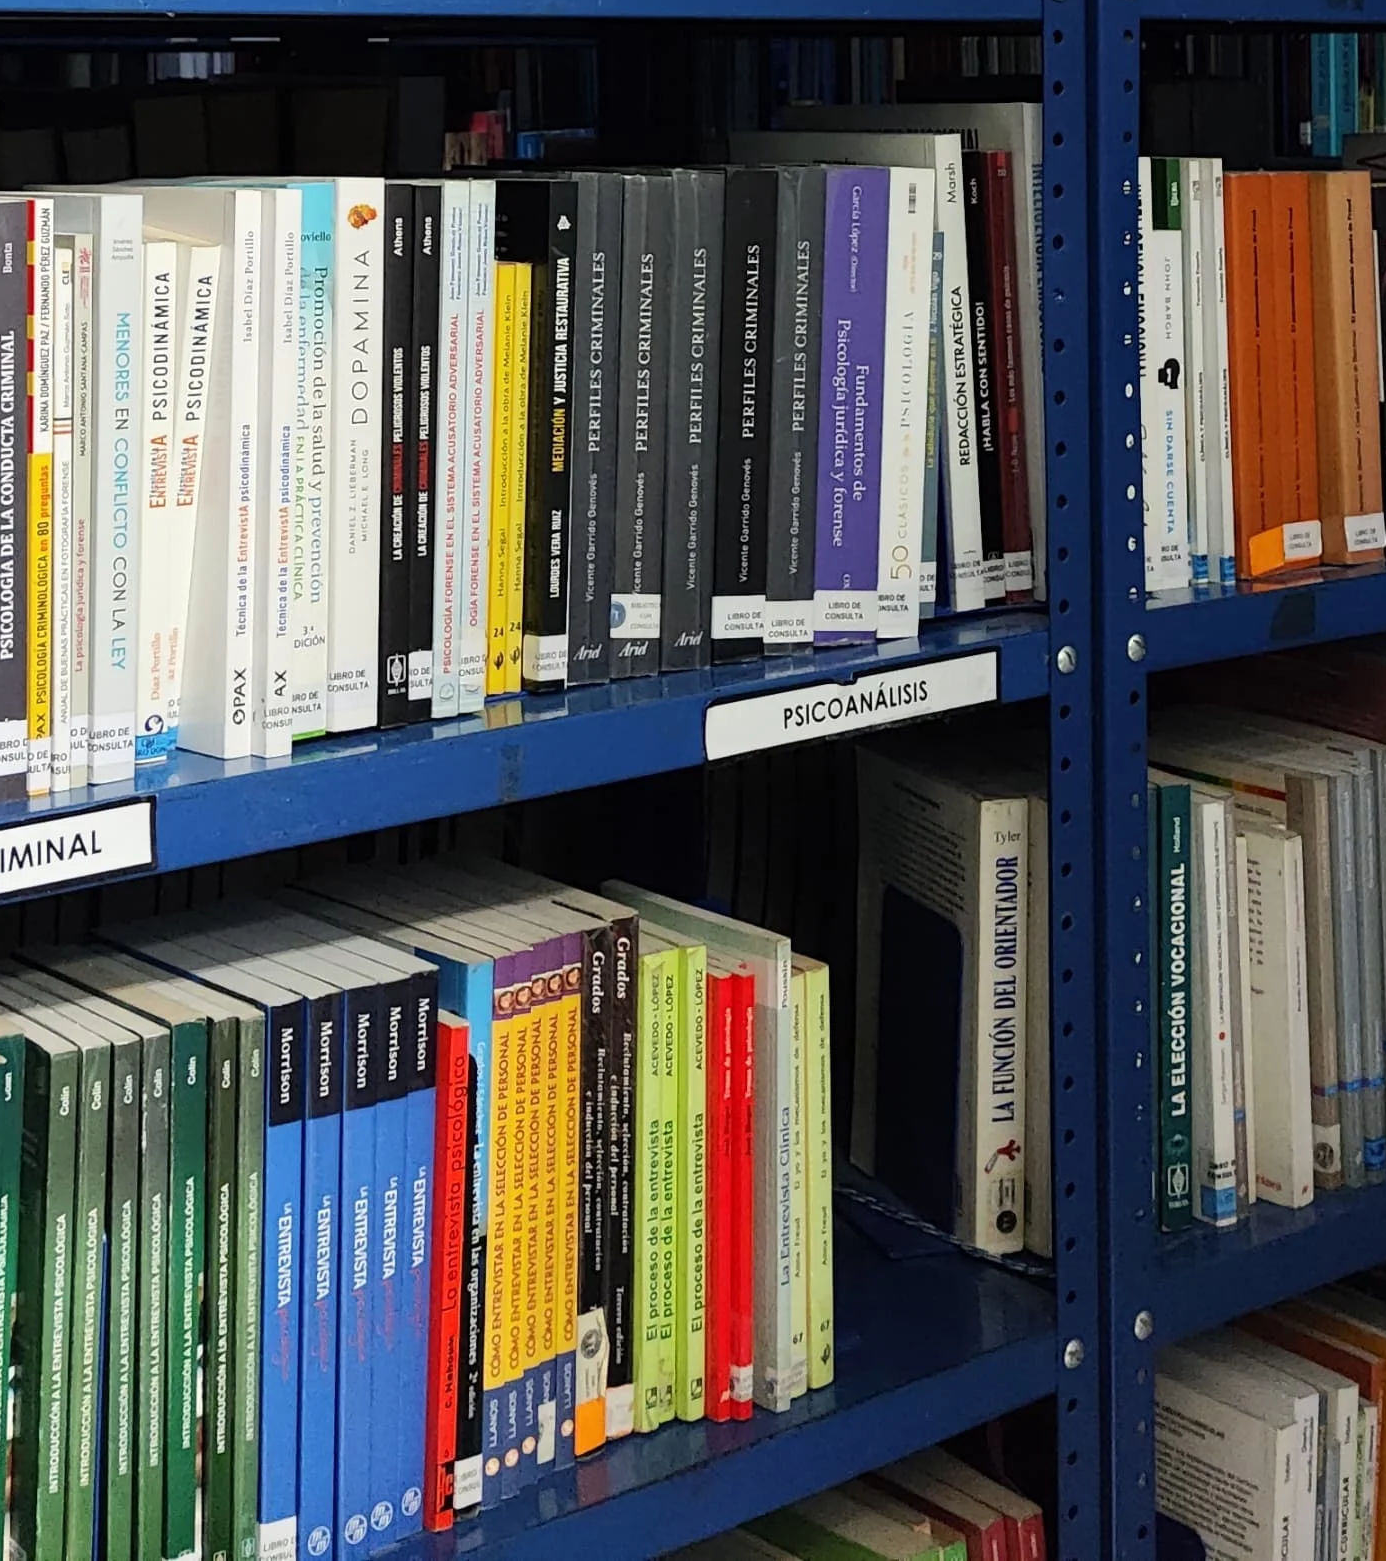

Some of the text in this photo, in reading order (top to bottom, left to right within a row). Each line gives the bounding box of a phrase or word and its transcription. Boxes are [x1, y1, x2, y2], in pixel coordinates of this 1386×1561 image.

[945, 162, 957, 204] Marsh
[351, 249, 370, 426] DOPAMINA
[555, 257, 570, 340] RESTAURATIVA
[741, 244, 761, 440] PERFILES CRIMINALES
[553, 343, 568, 393] JUSTICIA
[949, 285, 971, 467] REDACCIÓN ESTRATÉGICA
[110, 312, 130, 671] MENORES EN CONFLICTO CON LA LEY
[550, 406, 566, 473] MEDIACIÓN
[1165, 409, 1175, 535] SIN DARSE CUENTA
[783, 681, 929, 729] PSICOANÁLISIS
[994, 830, 1022, 845] Tyler
[592, 954, 605, 1015] Grados
[989, 855, 1018, 1124] LA FUNCIÓN DEL ORIENTADOR
[1167, 863, 1186, 1118] LA ELECCIÓN VOCACIONAL
[357, 1013, 370, 1089] Morrison
[691, 1113, 706, 1334] El proceso de la entrevista
